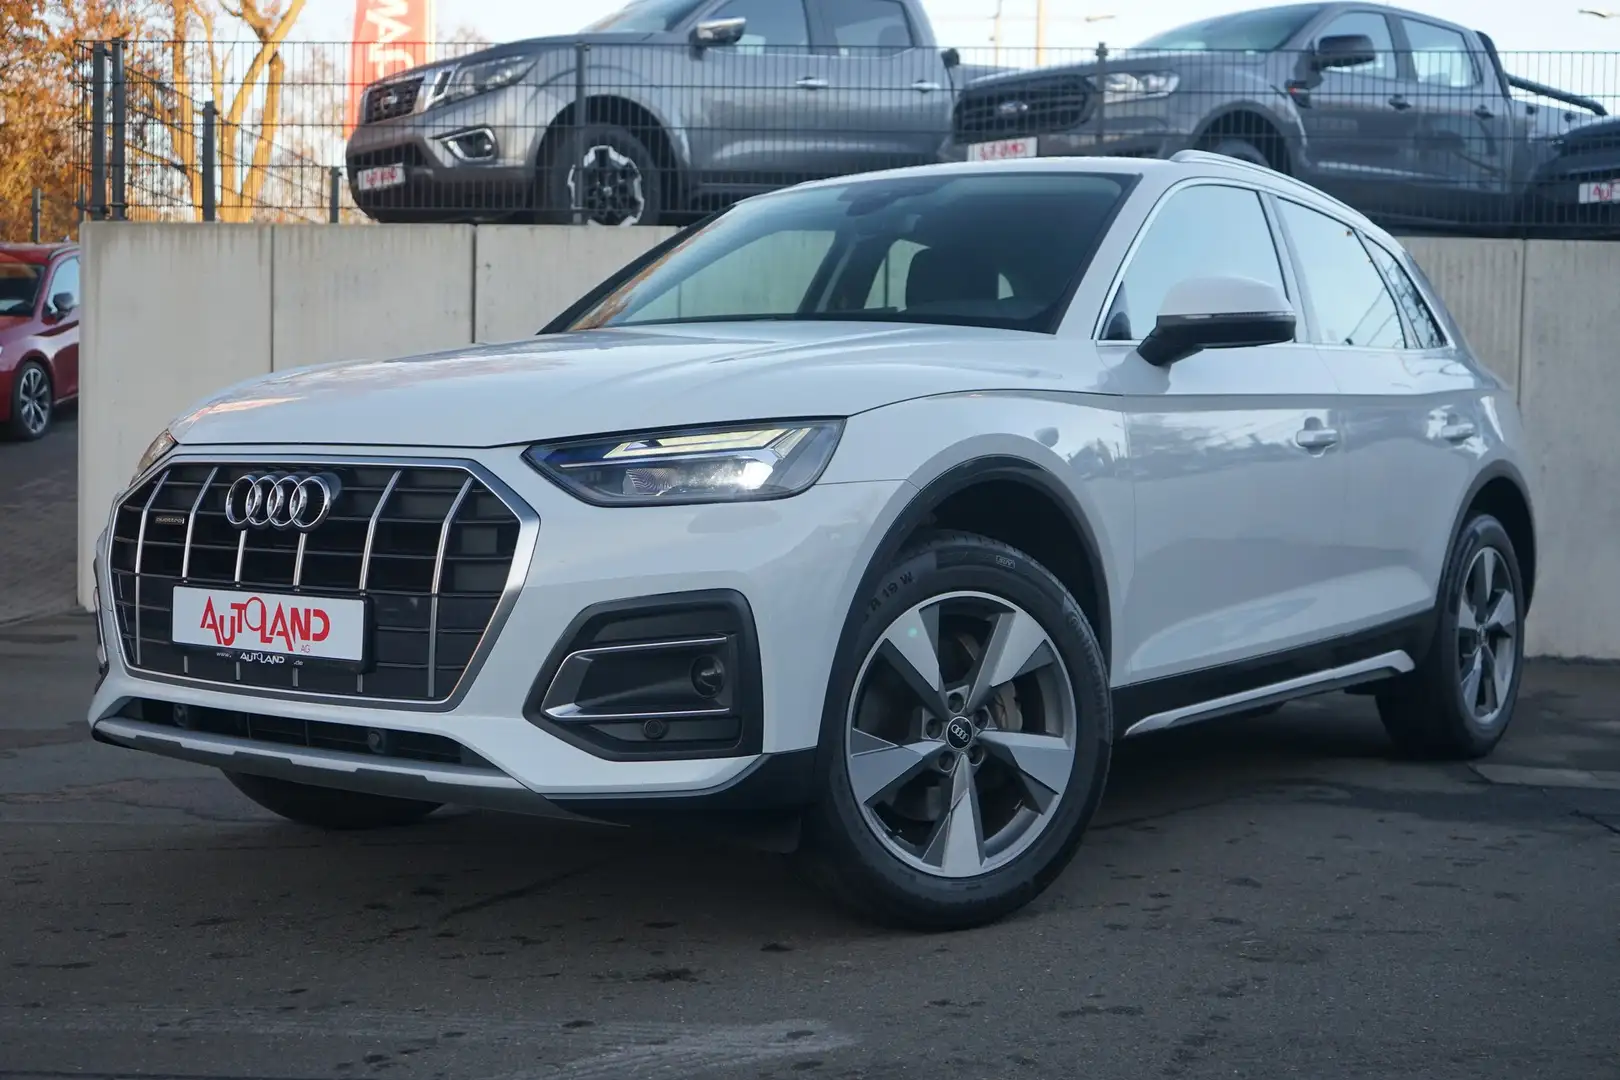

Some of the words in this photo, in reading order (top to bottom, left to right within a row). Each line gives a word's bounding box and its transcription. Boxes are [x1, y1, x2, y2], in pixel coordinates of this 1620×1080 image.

[200, 596, 331, 652] AUTOLAND
[301, 644, 311, 653] AG
[240, 652, 285, 664] AUTOLAND
